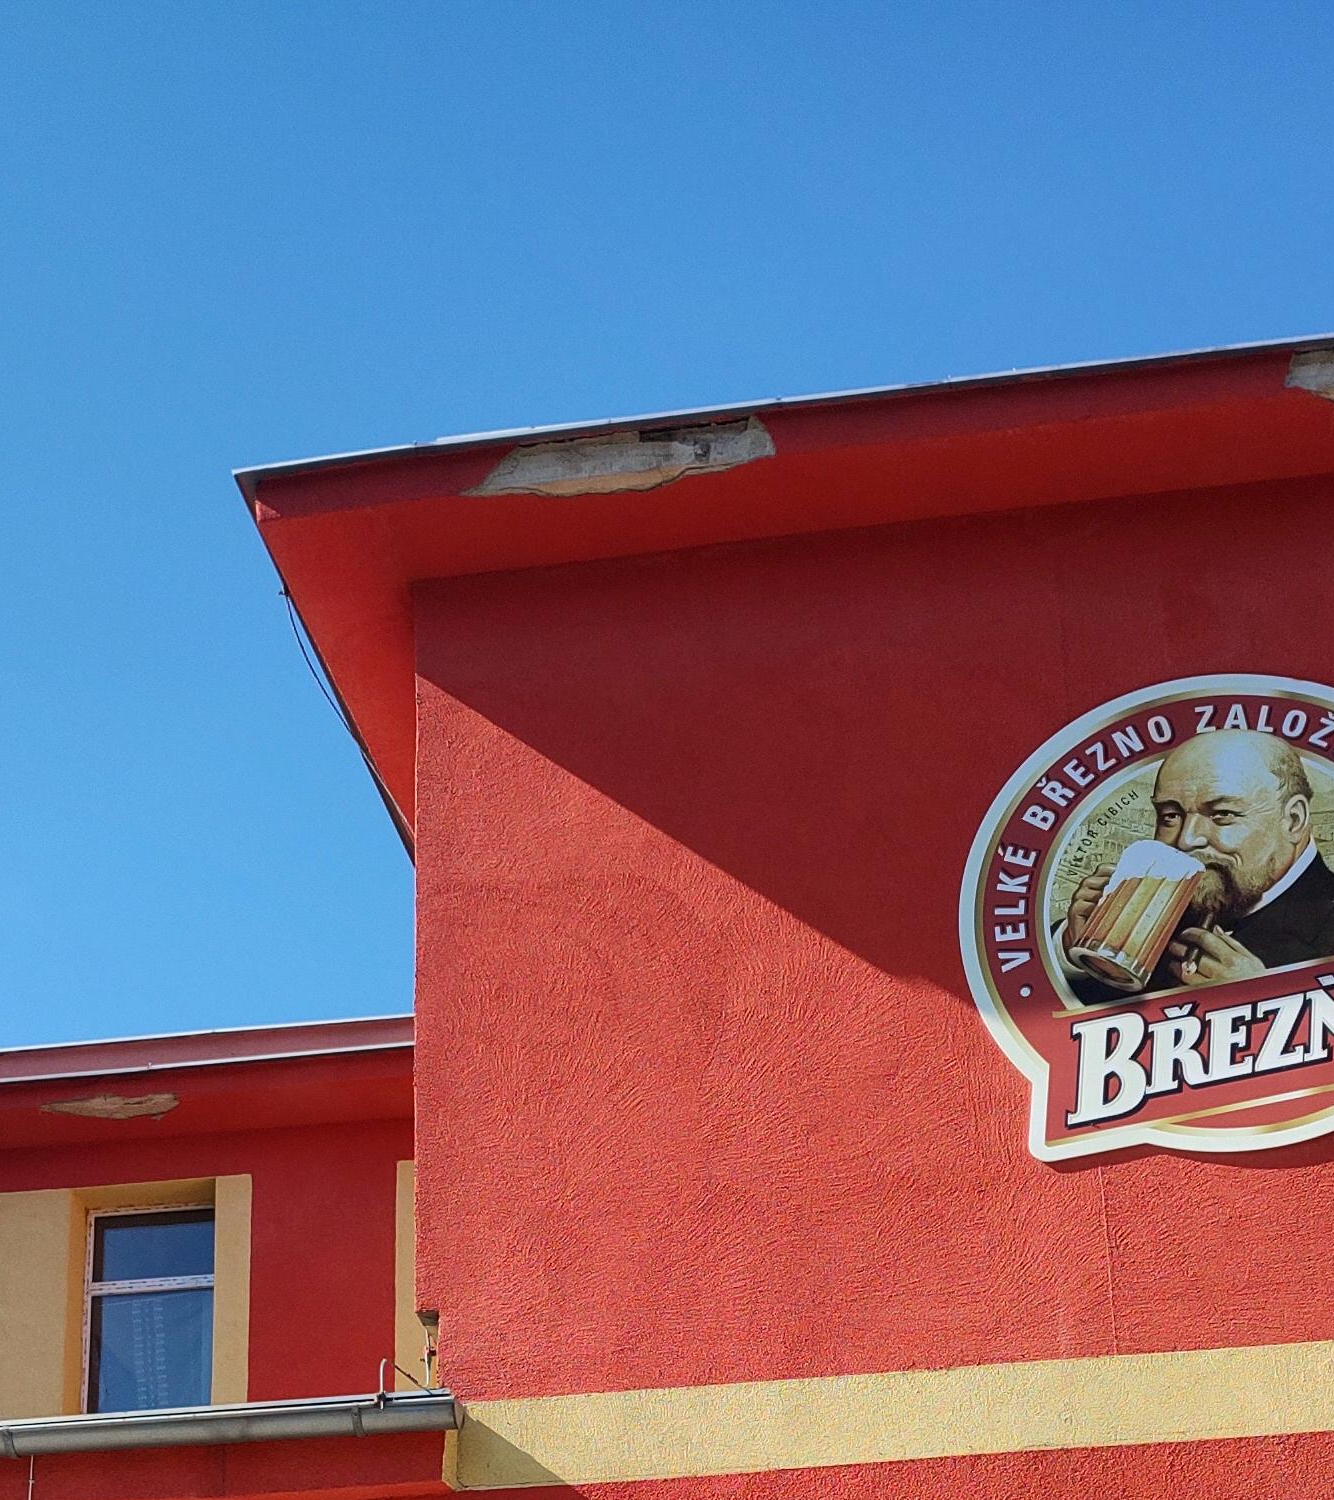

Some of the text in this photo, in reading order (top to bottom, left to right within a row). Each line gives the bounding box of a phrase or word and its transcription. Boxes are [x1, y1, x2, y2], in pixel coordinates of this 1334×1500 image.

[998, 843, 1040, 972] VELKÉ
[1022, 714, 1173, 833] BŘEZNO
[1067, 790, 1139, 876] VIKTOR CIBICH
